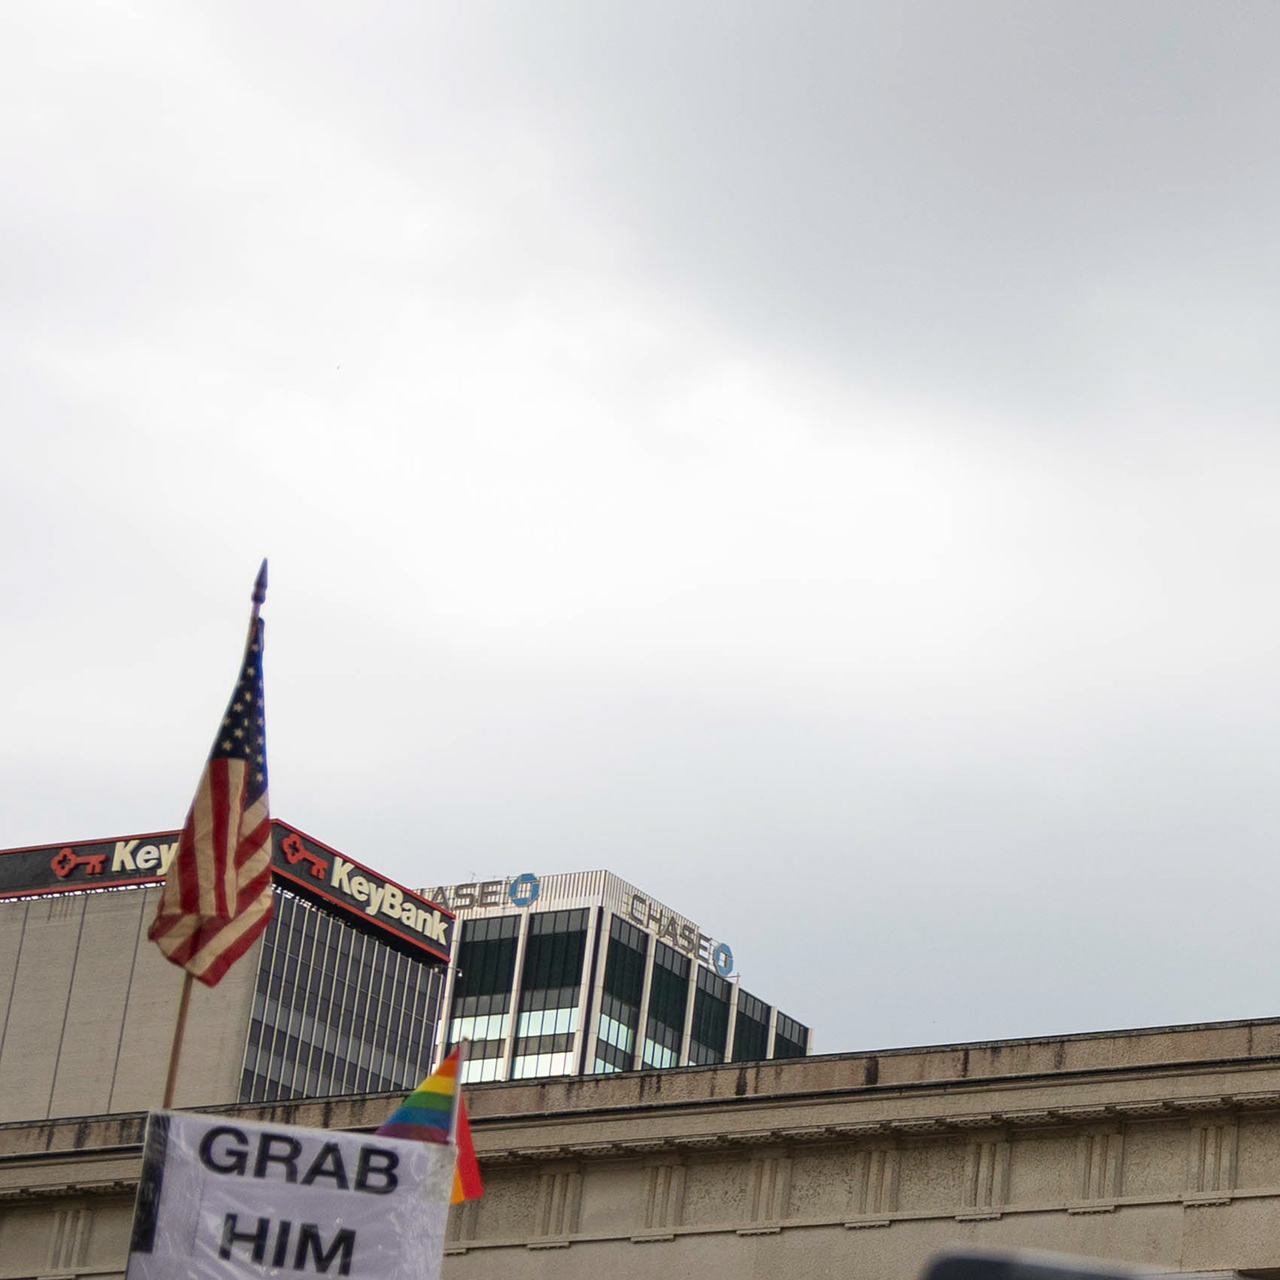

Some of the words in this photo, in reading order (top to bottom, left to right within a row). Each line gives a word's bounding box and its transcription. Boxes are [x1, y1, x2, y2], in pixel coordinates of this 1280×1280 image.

[331, 856, 448, 946] KeyBank
[420, 880, 503, 912] ASE
[630, 894, 711, 965] CHASE
[199, 1126, 401, 1195] GRAB
[219, 1213, 357, 1276] HIM
